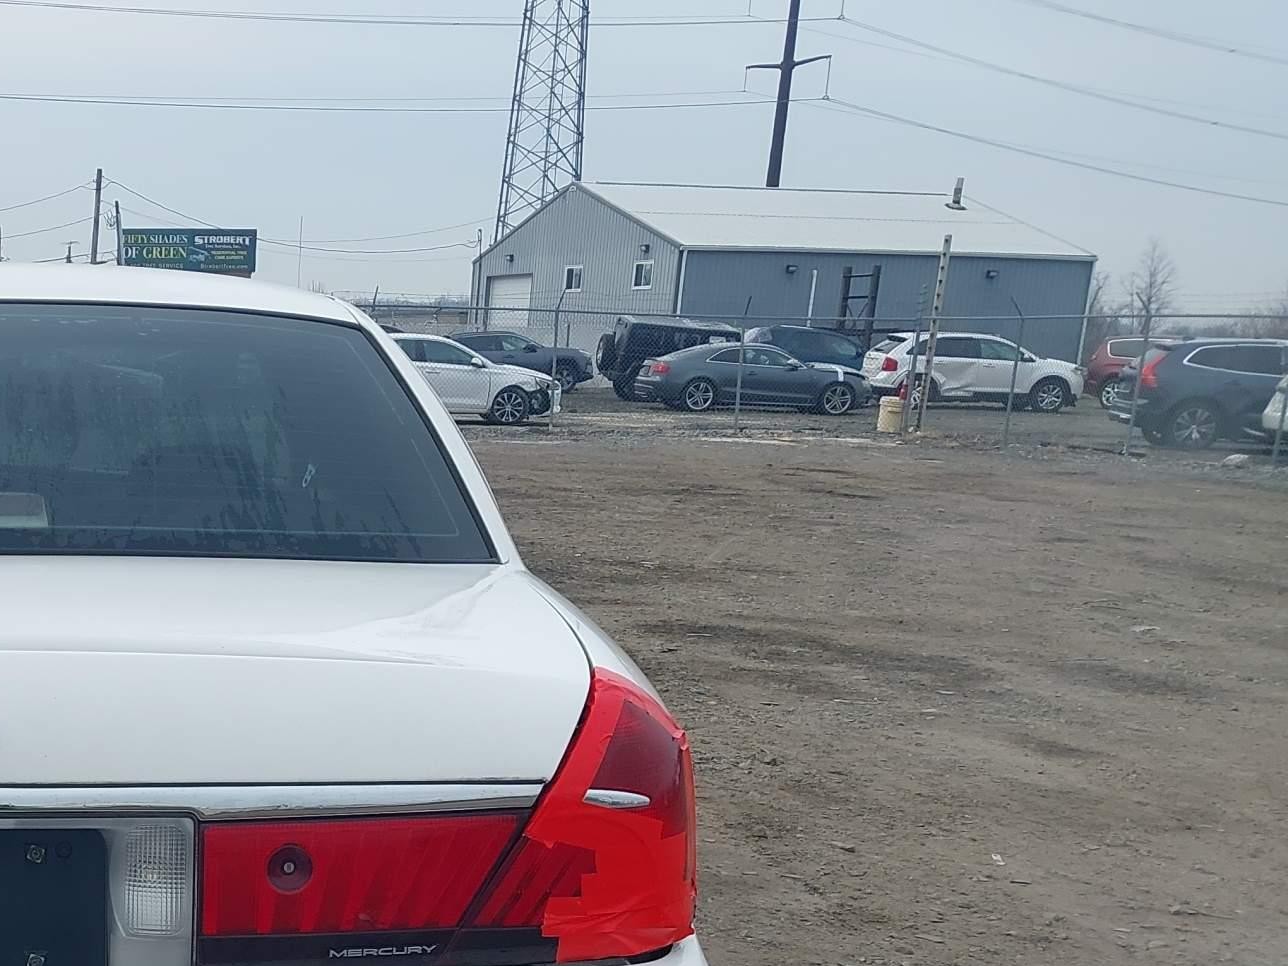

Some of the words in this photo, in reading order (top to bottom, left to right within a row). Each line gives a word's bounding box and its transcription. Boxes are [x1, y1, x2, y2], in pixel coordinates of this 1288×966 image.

[122, 234, 149, 244] FIFTY
[150, 234, 188, 244] SHADES
[194, 235, 252, 245] STROBERT
[123, 246, 140, 259] OF
[142, 246, 187, 259] GREEN
[329, 944, 438, 958] MERCURY
